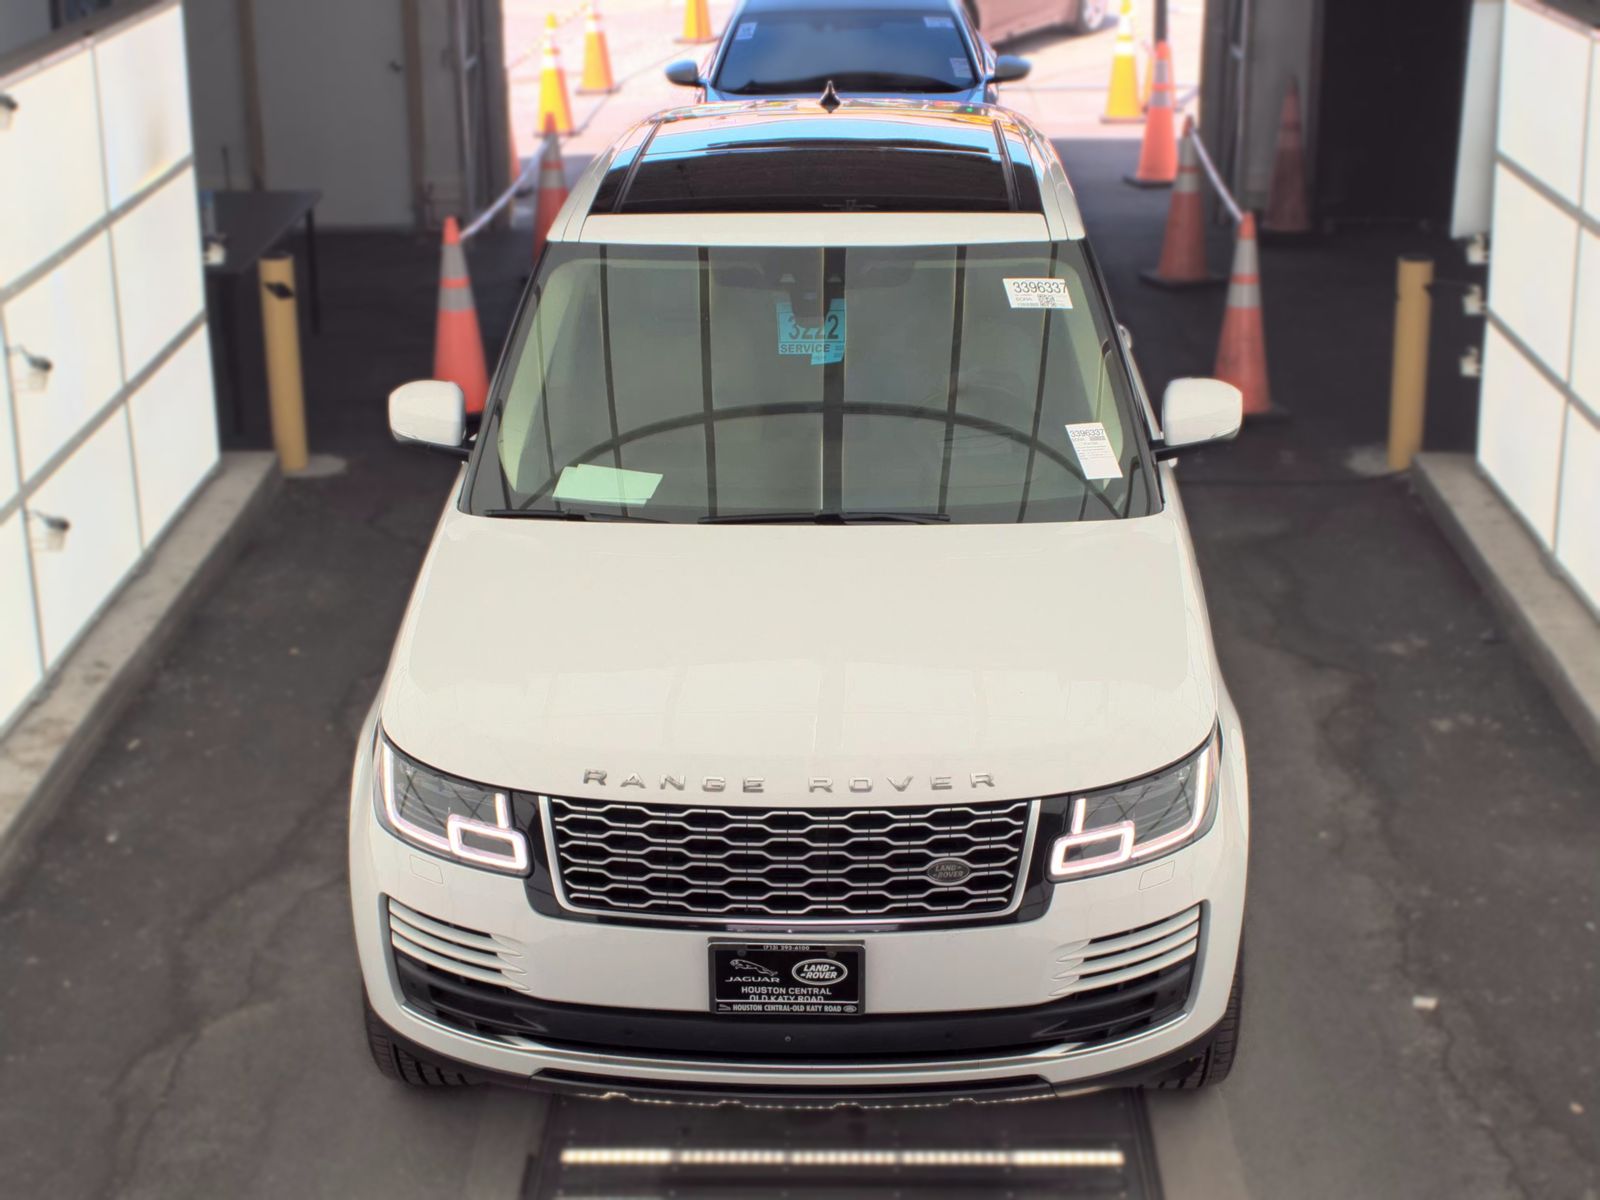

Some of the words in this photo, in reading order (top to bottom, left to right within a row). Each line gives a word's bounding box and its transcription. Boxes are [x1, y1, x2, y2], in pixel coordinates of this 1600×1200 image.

[1013, 281, 1066, 294] 3396337
[780, 343, 831, 353] SERVICE
[583, 768, 765, 793] RANGE
[808, 772, 996, 793] ROVER
[741, 986, 788, 994] HOUSTON
[788, 987, 832, 995] CENTRAL
